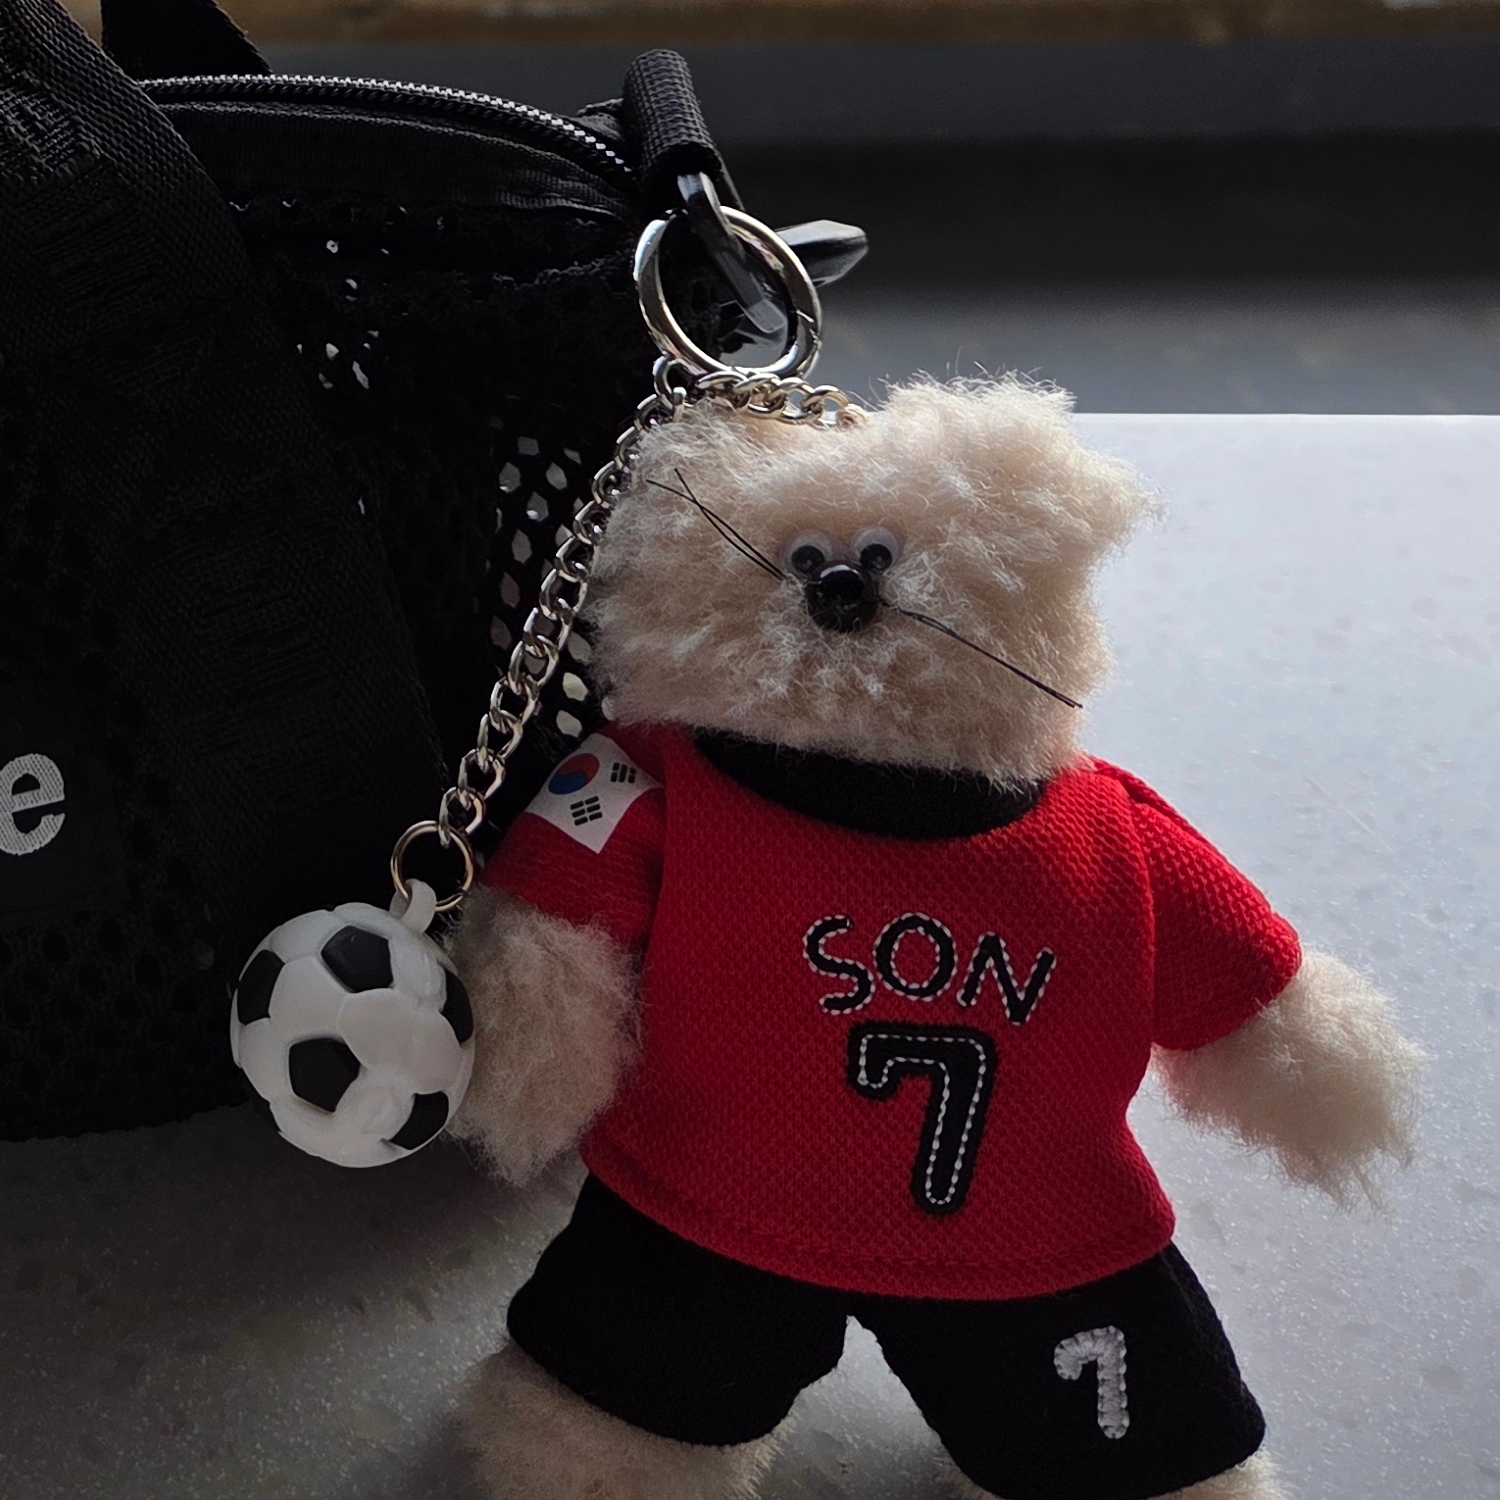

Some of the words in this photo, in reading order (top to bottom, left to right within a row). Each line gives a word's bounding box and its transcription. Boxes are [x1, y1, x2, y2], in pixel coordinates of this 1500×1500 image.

[802, 912, 1057, 1026] SON
[847, 1021, 998, 1215] 7
[1053, 1325, 1130, 1439] 7
